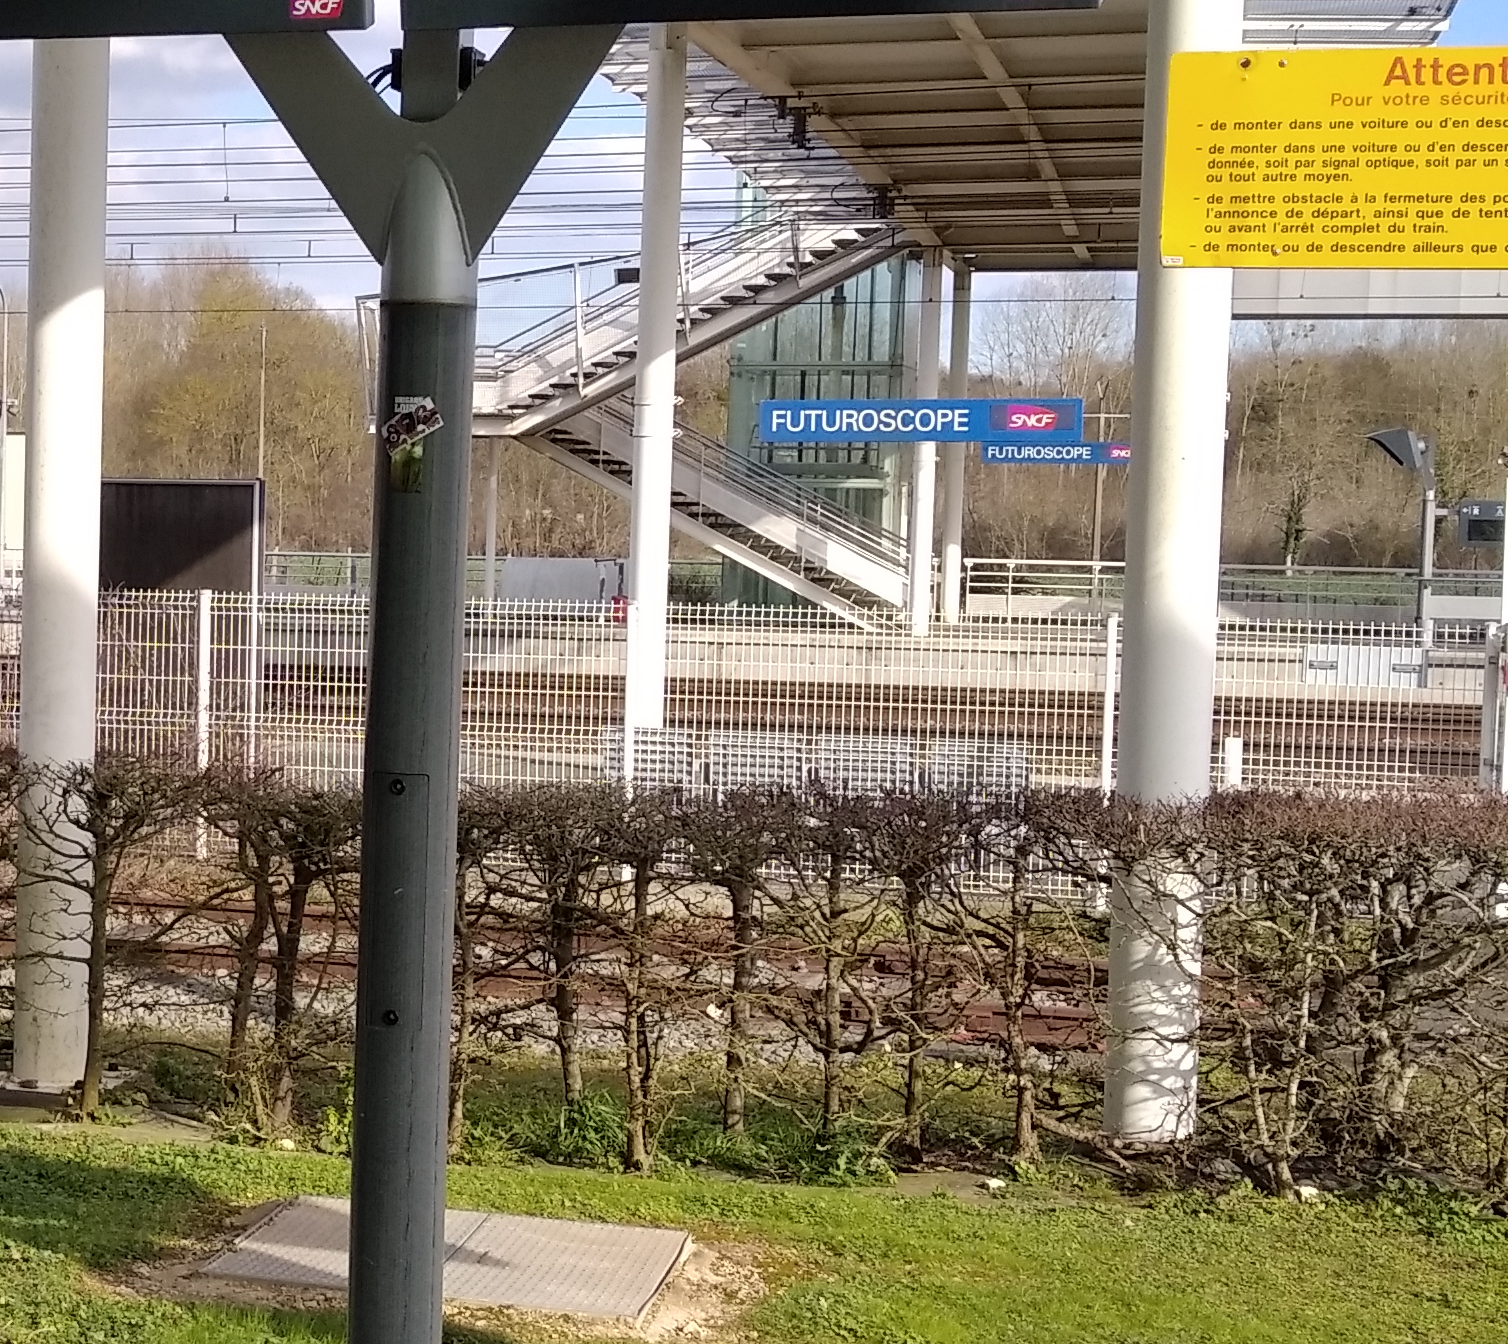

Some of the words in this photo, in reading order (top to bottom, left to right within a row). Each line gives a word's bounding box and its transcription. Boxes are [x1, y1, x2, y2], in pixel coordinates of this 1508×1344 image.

[1330, 92, 1373, 107] Pour
[1383, 92, 1430, 106] votre
[1440, 91, 1508, 106] sécurit
[1210, 120, 1227, 131] de
[1233, 119, 1283, 131] monter
[1289, 119, 1323, 130] dans
[1329, 120, 1354, 130] une
[1361, 118, 1409, 129] voiture
[1415, 119, 1433, 129] ou
[1440, 117, 1469, 129] d'en
[1208, 143, 1225, 155] de
[1230, 143, 1278, 154] monter
[1284, 142, 1316, 154] dans
[1321, 144, 1346, 154] une
[1352, 142, 1398, 153] voiture
[1404, 143, 1421, 153] ou
[1427, 141, 1456, 153] d'en
[1207, 158, 1260, 170] donnée,
[1265, 157, 1289, 169] soit
[1294, 159, 1316, 171] par
[1321, 157, 1360, 171] signal
[1365, 156, 1419, 170] optique,
[1424, 156, 1450, 168] soit
[1455, 158, 1477, 170] par
[1483, 158, 1499, 168] un
[1206, 173, 1223, 183] ou
[1229, 171, 1256, 183] tout
[1262, 171, 1297, 182] autre
[1303, 172, 1353, 184] moyen.
[1207, 193, 1224, 205] de
[1230, 193, 1276, 204] mettre
[1282, 192, 1344, 204] obstacle
[1350, 192, 1359, 204] à
[1364, 192, 1377, 204] la
[1383, 192, 1453, 204] fermeture
[1460, 192, 1487, 204] des
[1206, 208, 1278, 219] l'annonce
[1285, 208, 1304, 219] de
[1311, 207, 1366, 221] départ,
[1373, 207, 1409, 219] ainsi
[1415, 209, 1444, 221] que
[1451, 207, 1471, 219] de
[1204, 223, 1222, 233] ou
[1228, 223, 1267, 233] avant
[1273, 222, 1315, 233] l'arrêt
[1321, 222, 1381, 236] complet
[1388, 222, 1406, 233] du
[1413, 222, 1449, 233] train.
[1203, 242, 1220, 253] de
[1226, 242, 1276, 253] monter
[1282, 242, 1300, 253] ou
[1306, 242, 1323, 253] de
[1330, 242, 1406, 253] descendre
[1412, 241, 1464, 253] ailleurs
[1470, 243, 1498, 255] que
[771, 409, 969, 432] FUTUROSCOPE
[1008, 414, 1053, 427] SNCF
[987, 445, 1092, 460] FUTUROSCOPE
